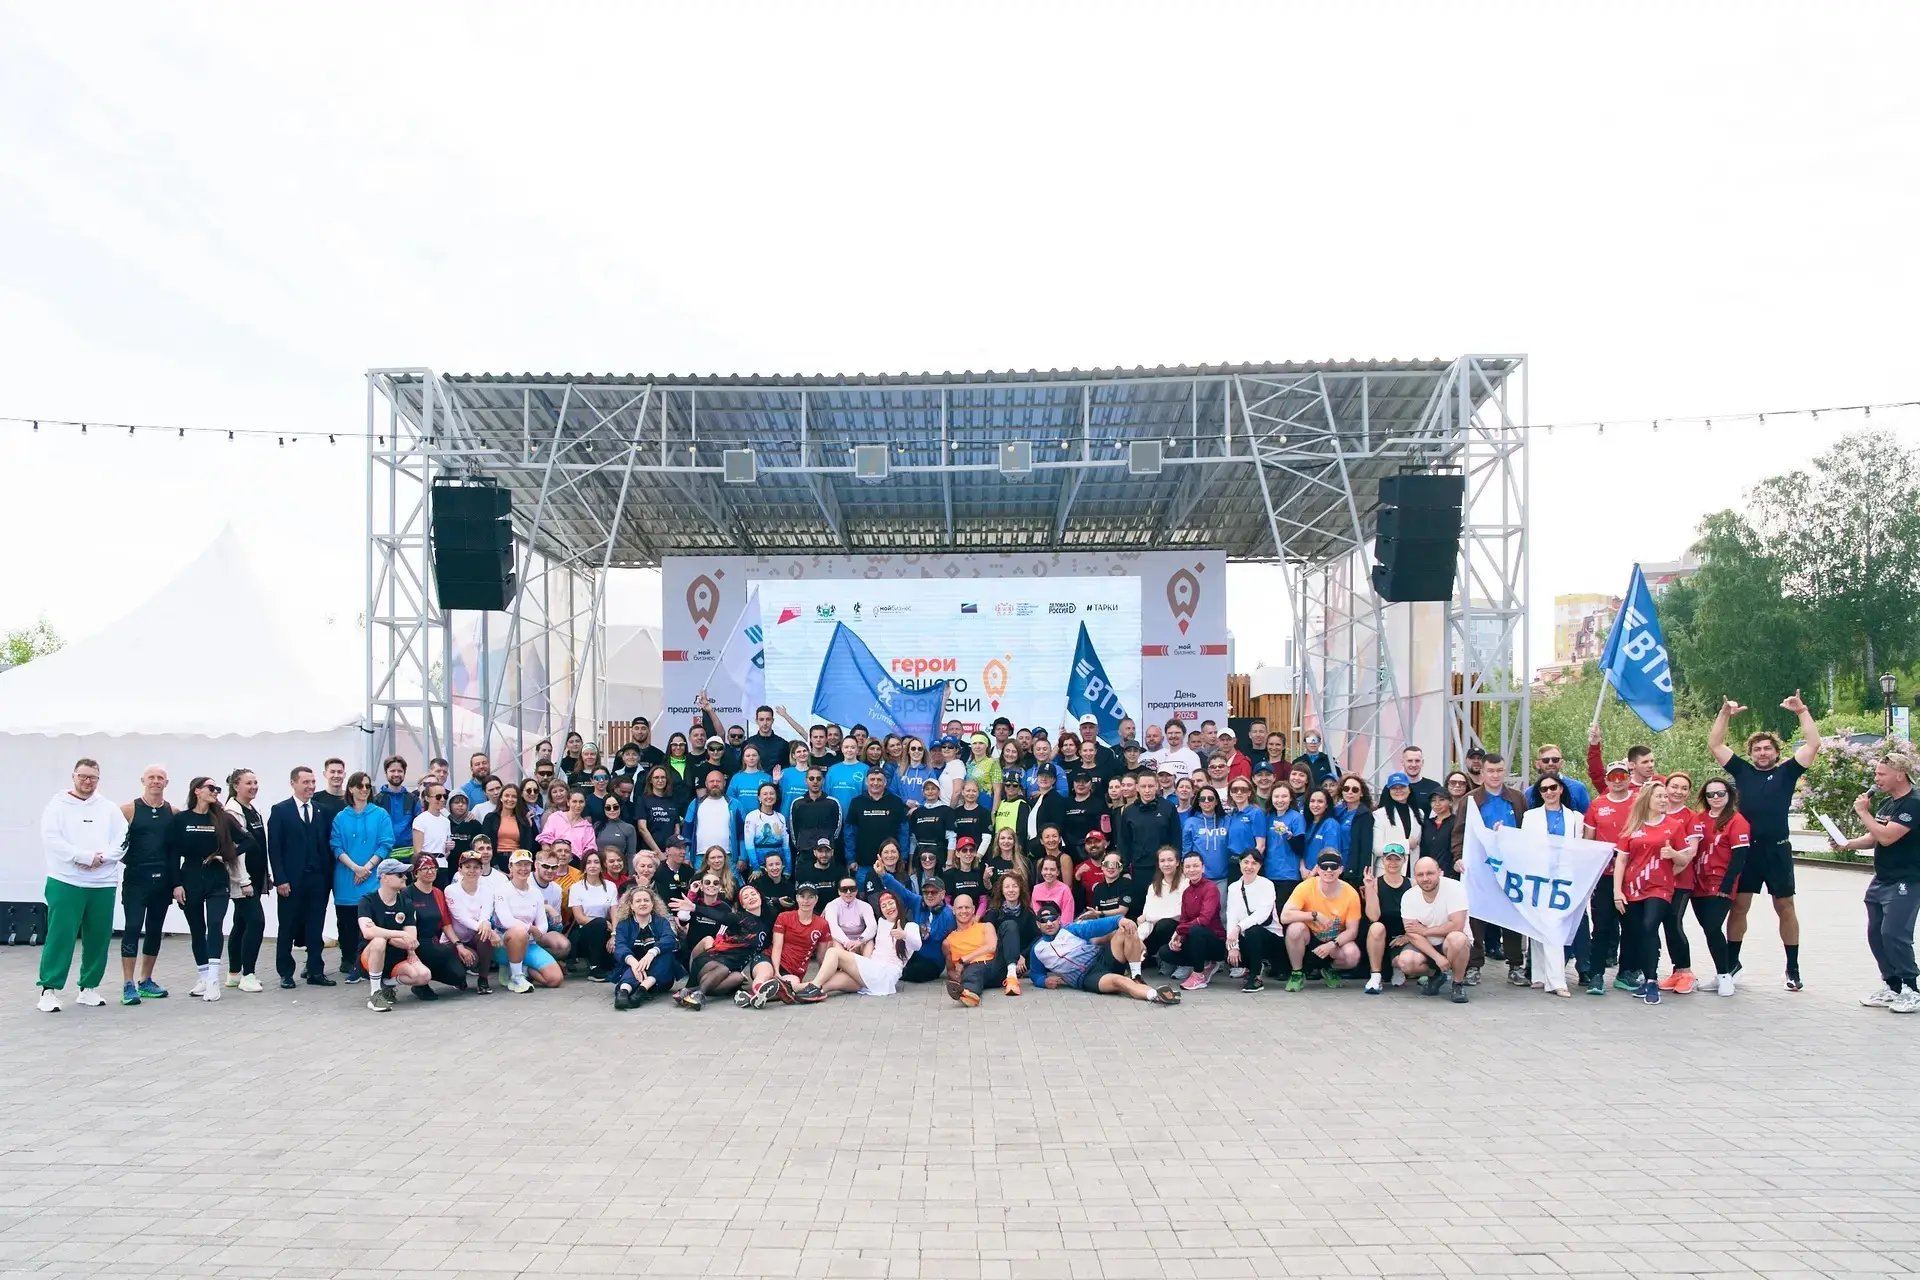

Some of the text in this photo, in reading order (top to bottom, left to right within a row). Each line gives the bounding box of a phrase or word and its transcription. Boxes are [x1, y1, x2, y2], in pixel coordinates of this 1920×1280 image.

[891, 657, 957, 678] герои
[1173, 690, 1197, 700] День
[1147, 701, 1224, 710] предпринимателя
[1176, 711, 1195, 719] 2026
[1206, 827, 1227, 837] VTB
[1503, 870, 1573, 911] ВТБ
